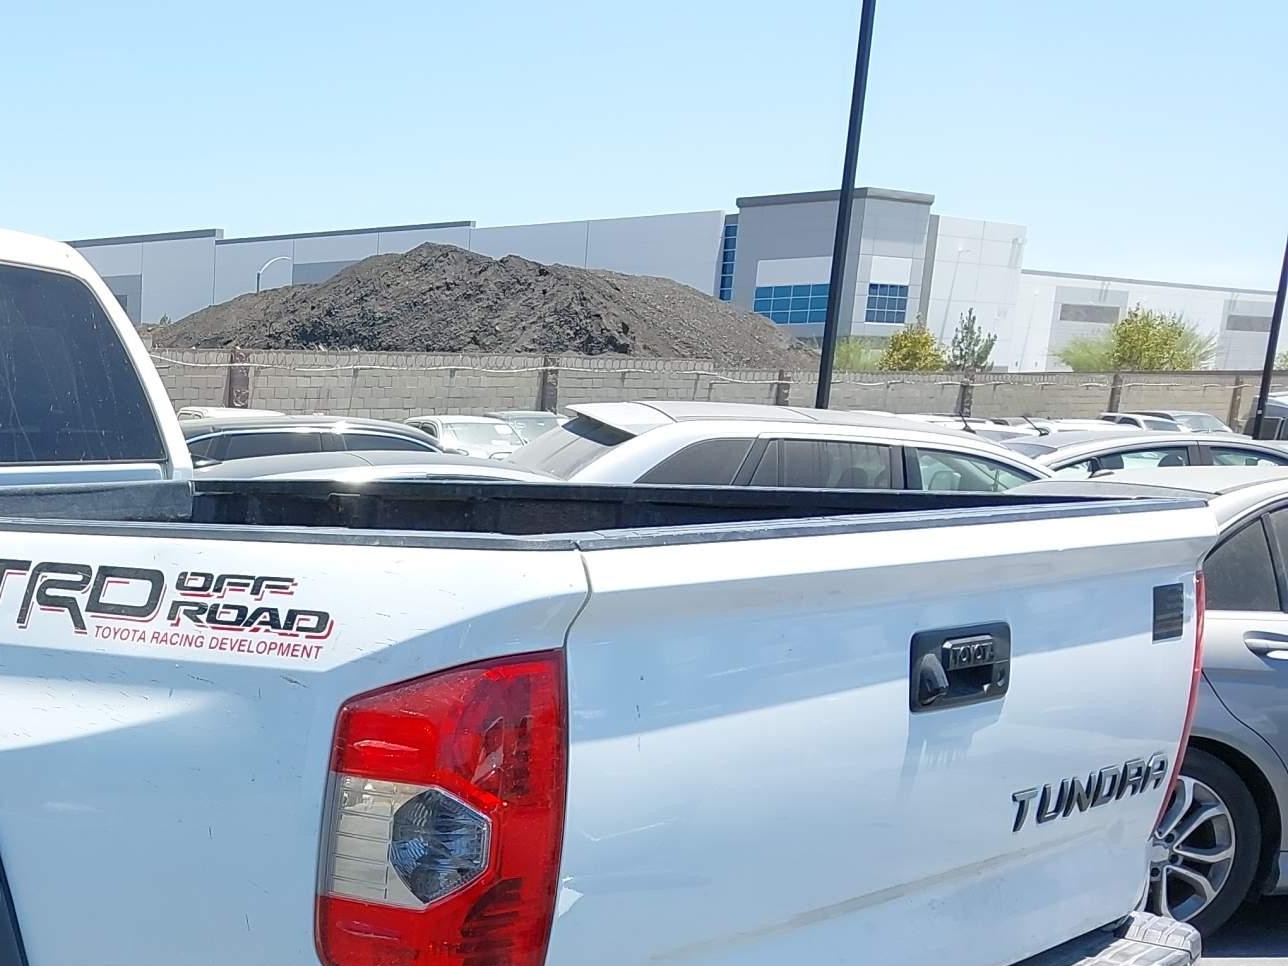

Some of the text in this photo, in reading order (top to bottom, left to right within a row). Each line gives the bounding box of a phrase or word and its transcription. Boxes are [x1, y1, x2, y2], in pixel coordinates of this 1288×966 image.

[175, 571, 298, 600] OFF
[167, 600, 334, 640] ROAD
[94, 625, 323, 660] TOYOTA RACING DEVELOPMENT
[1011, 751, 1169, 832] TUNDRA
